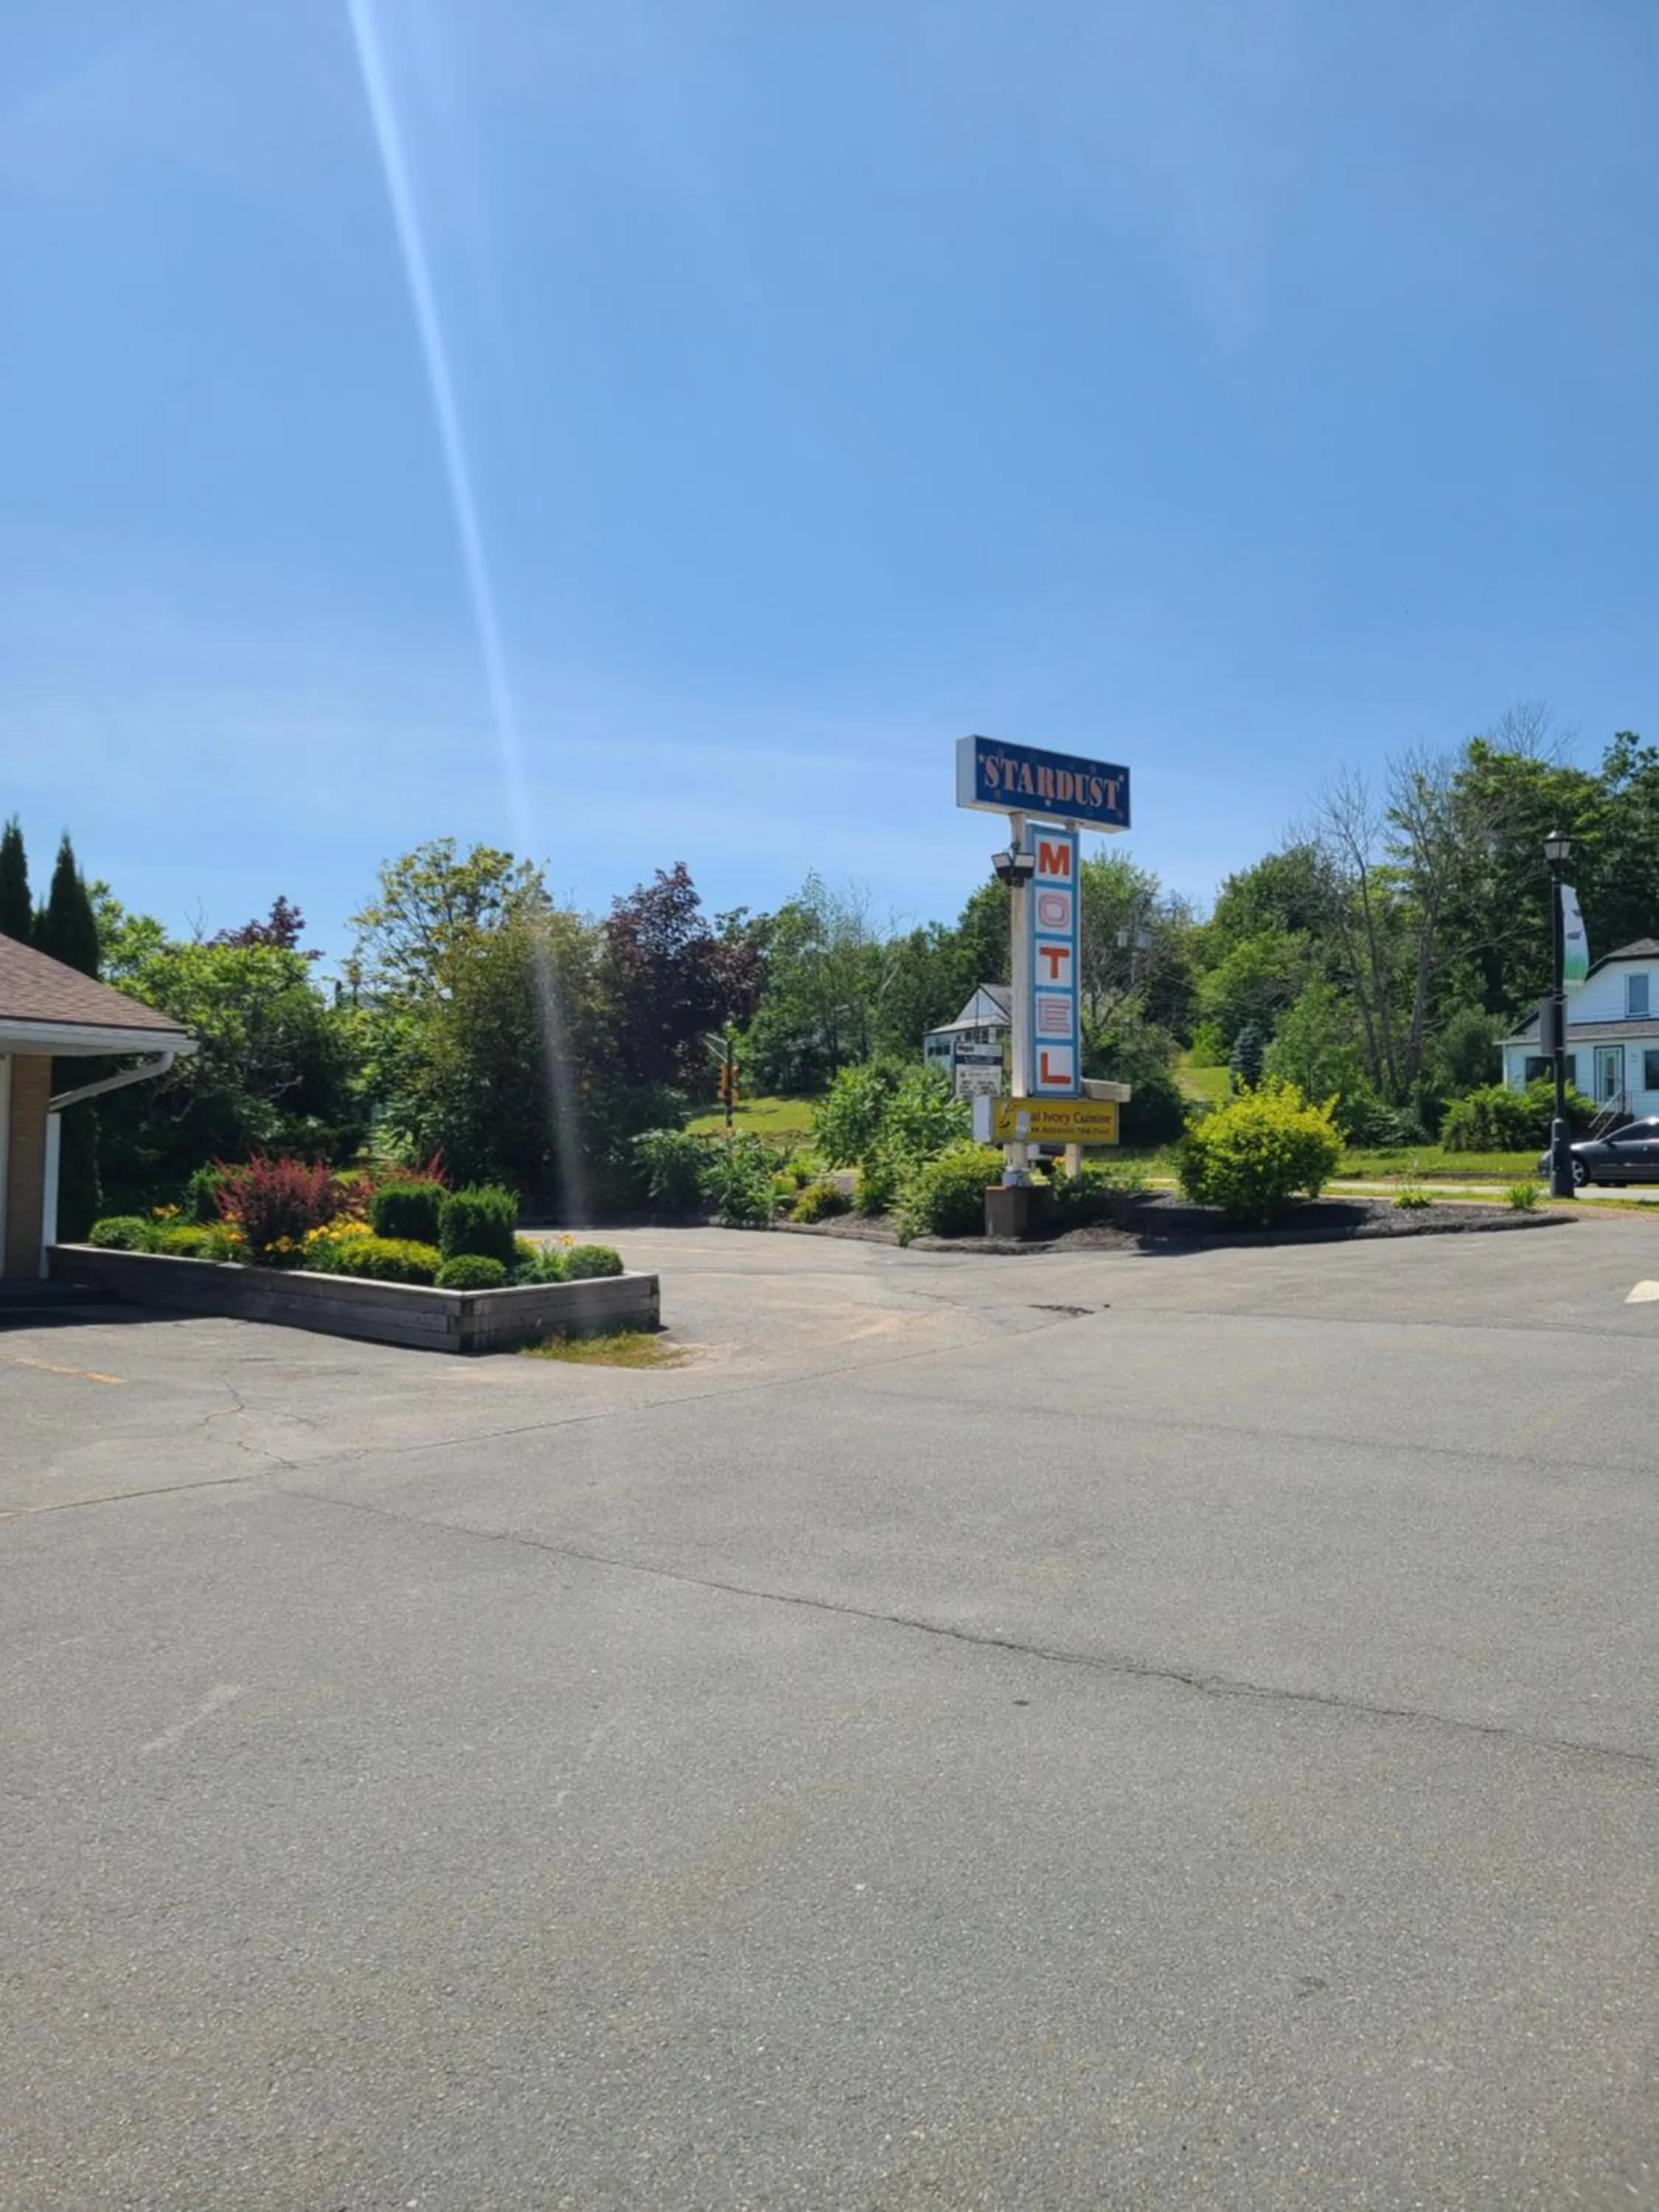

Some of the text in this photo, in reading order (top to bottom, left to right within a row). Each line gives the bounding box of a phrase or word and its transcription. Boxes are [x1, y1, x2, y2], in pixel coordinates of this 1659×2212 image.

[984, 754, 1120, 810] STARDUST
[1038, 841, 1071, 1085] MOTEL
[1042, 1110, 1069, 1125] Ivory
[1074, 1111, 1112, 1124] Cuisine
